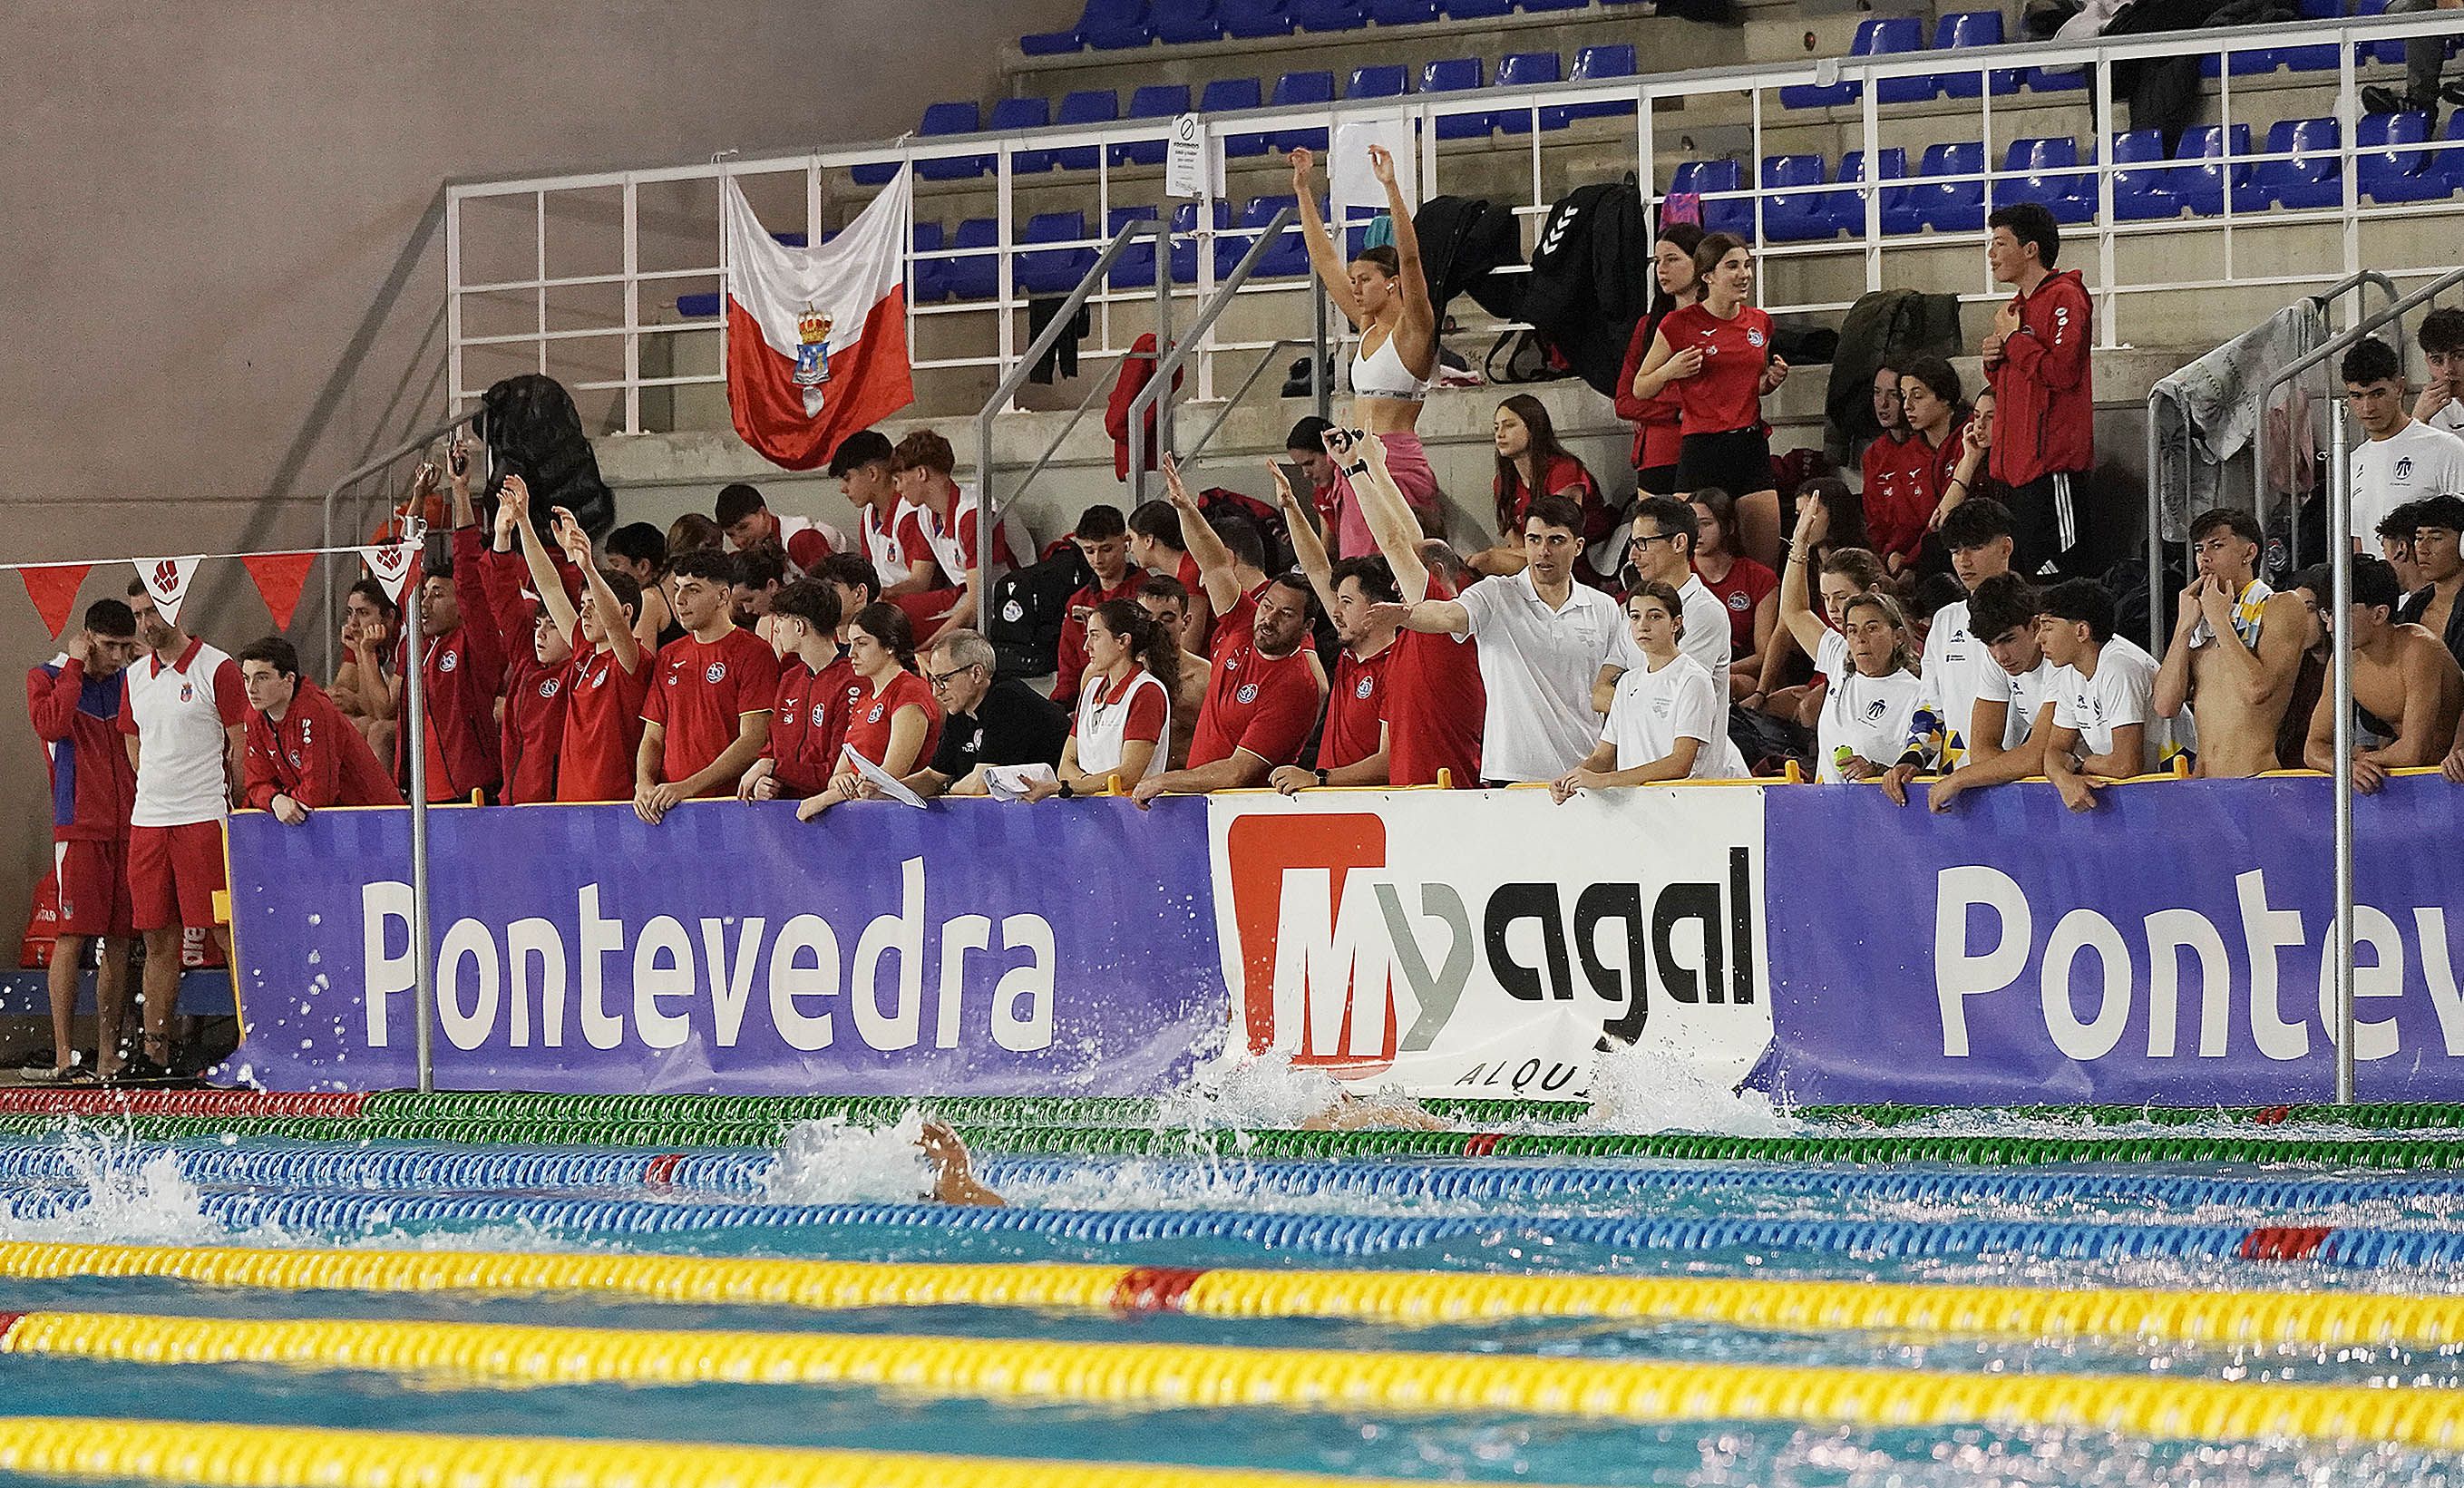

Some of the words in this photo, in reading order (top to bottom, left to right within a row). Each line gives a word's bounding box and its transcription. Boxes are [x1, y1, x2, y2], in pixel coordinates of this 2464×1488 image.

[363, 856, 1056, 1052] Pontevedra
[1271, 846, 1754, 1055] Myagal
[1454, 1057, 1589, 1098] ALQU
